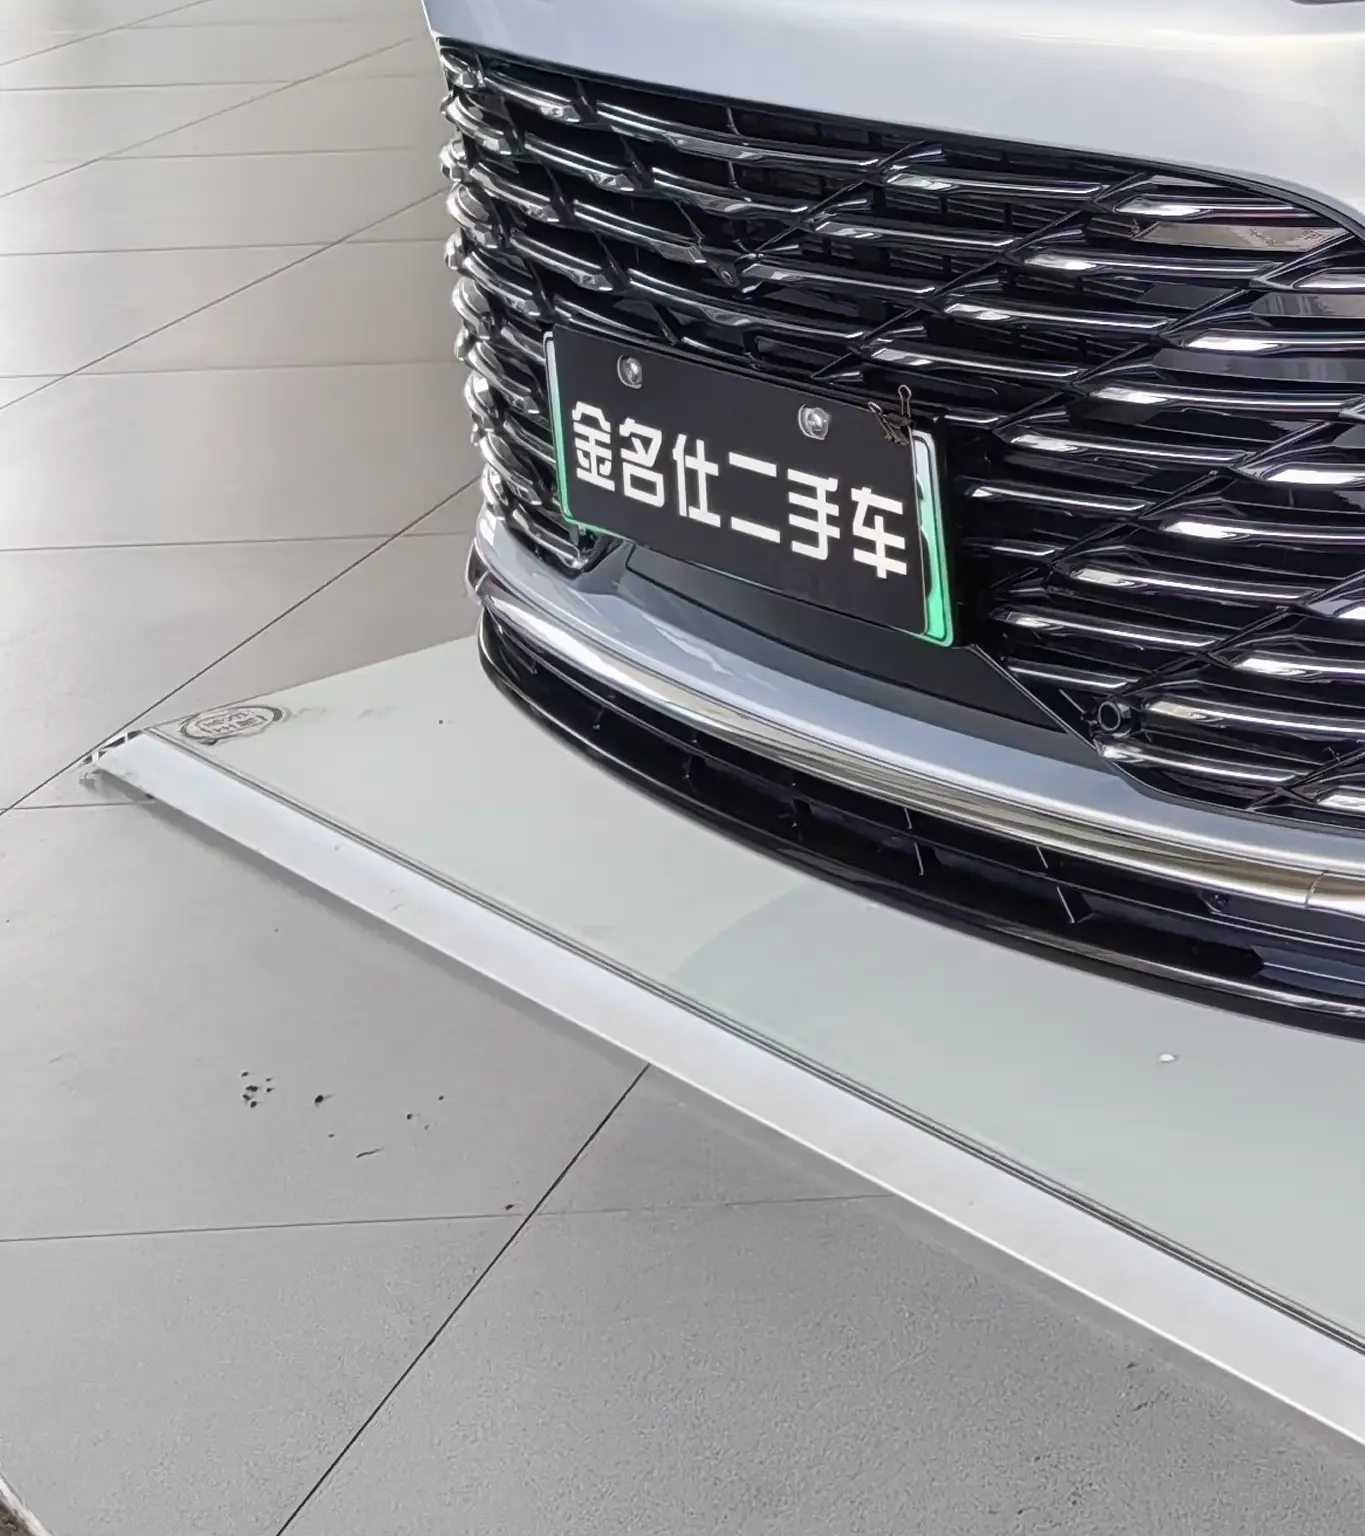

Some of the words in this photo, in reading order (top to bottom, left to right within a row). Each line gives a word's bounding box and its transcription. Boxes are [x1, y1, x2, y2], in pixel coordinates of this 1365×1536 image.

[571, 400, 908, 579] 金名仕二手车
